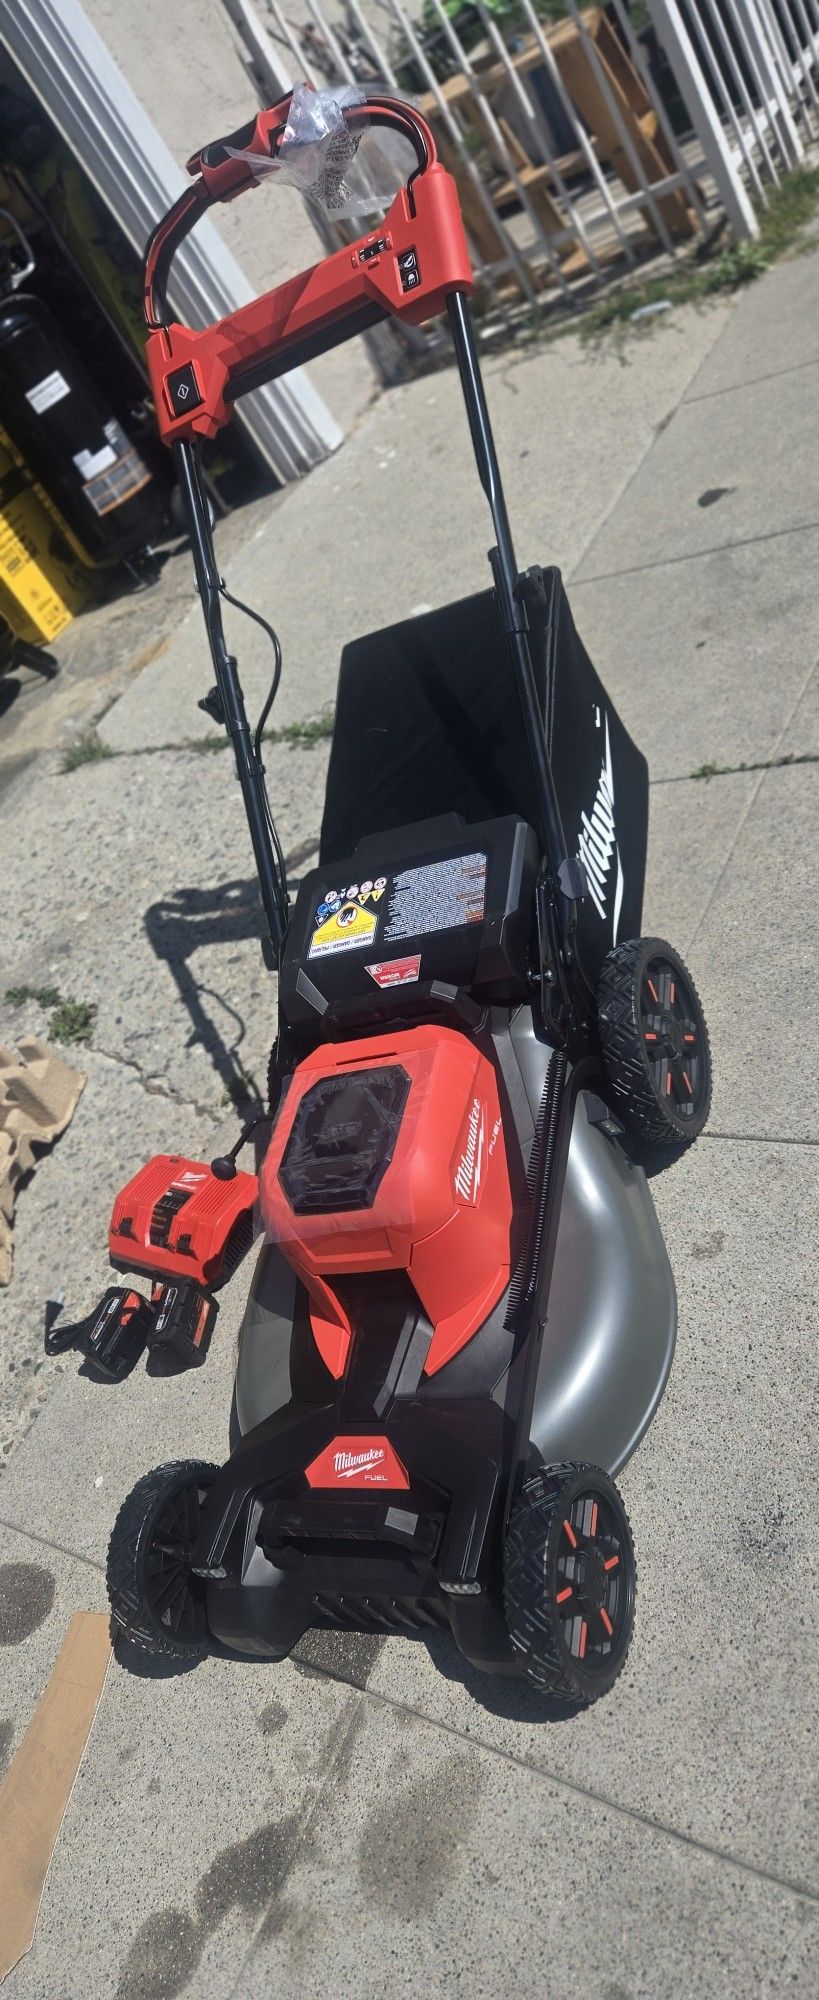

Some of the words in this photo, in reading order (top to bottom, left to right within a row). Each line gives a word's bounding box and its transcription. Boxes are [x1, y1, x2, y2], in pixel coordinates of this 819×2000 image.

[454, 1098, 481, 1201] Milwaukee
[488, 1117, 503, 1156] FUEL
[333, 1448, 384, 1472] Milwaukee
